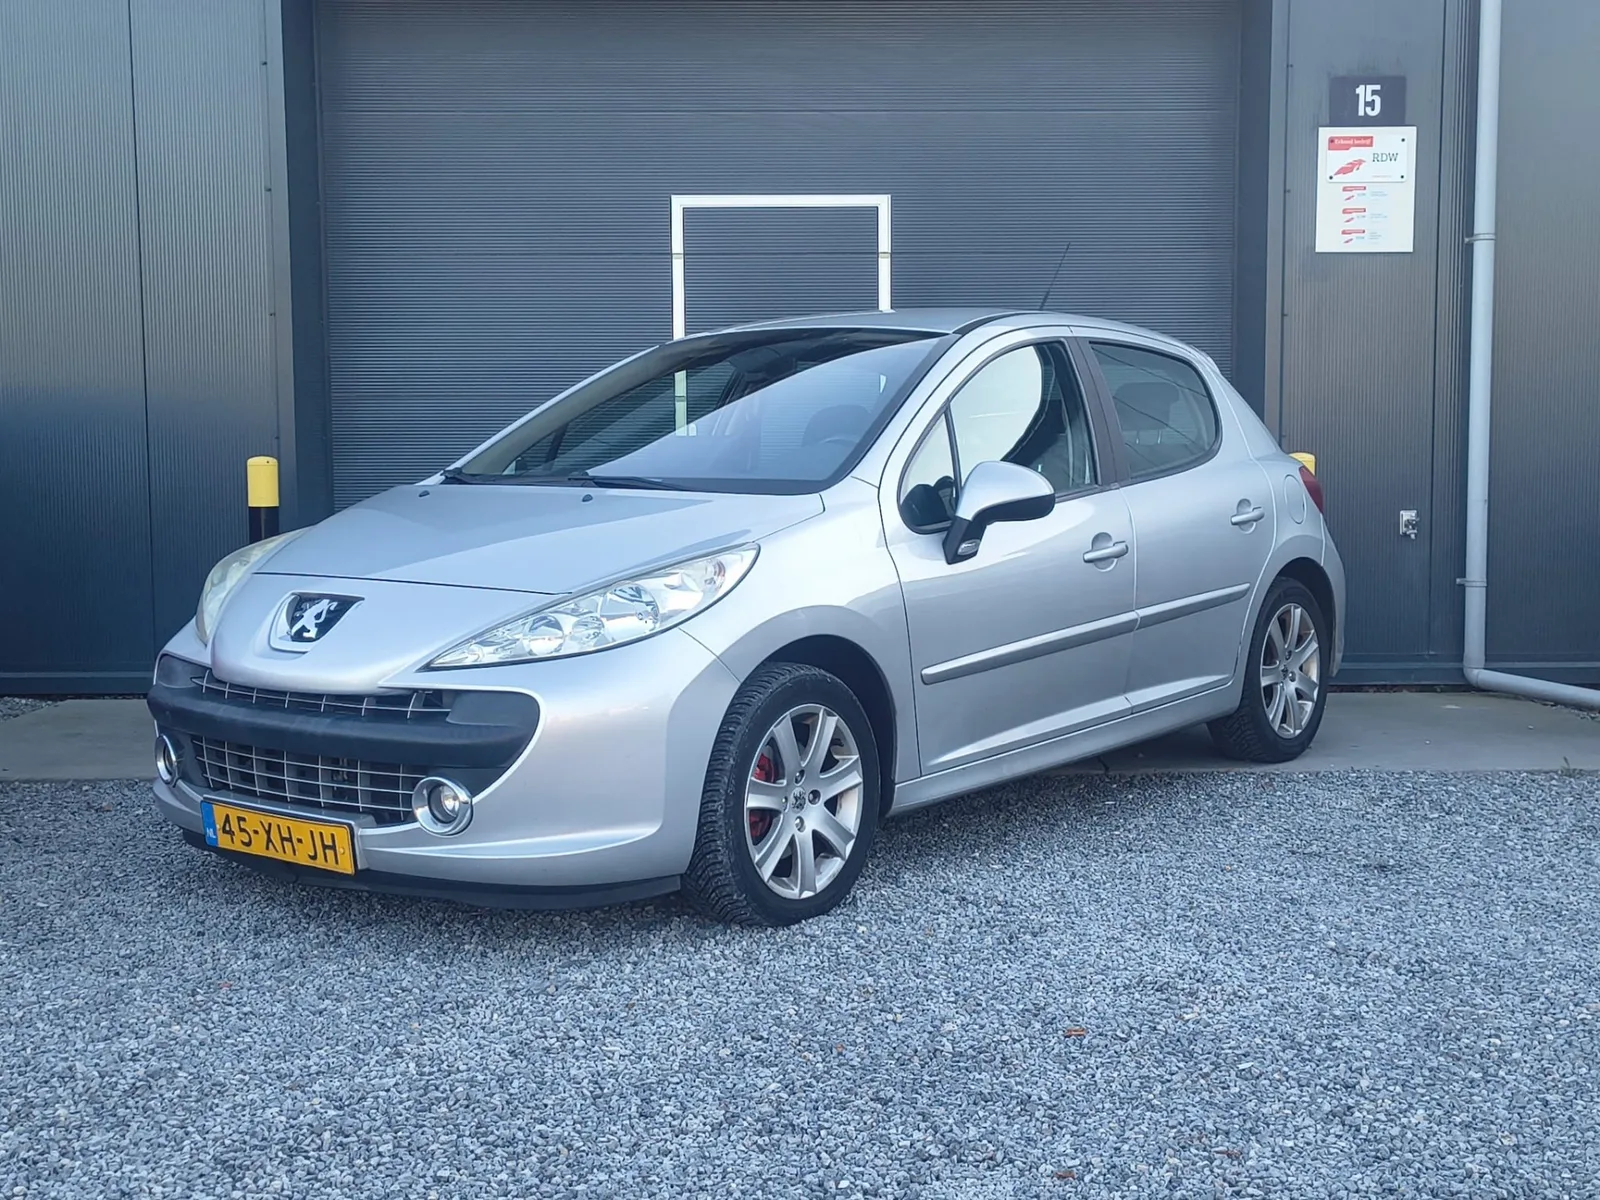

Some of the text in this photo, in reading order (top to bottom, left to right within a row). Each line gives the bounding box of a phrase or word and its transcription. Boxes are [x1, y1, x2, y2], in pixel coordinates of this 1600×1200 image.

[1355, 84, 1382, 117] 15
[1372, 153, 1399, 162] RDW
[221, 813, 339, 866] 45-XH-JH
